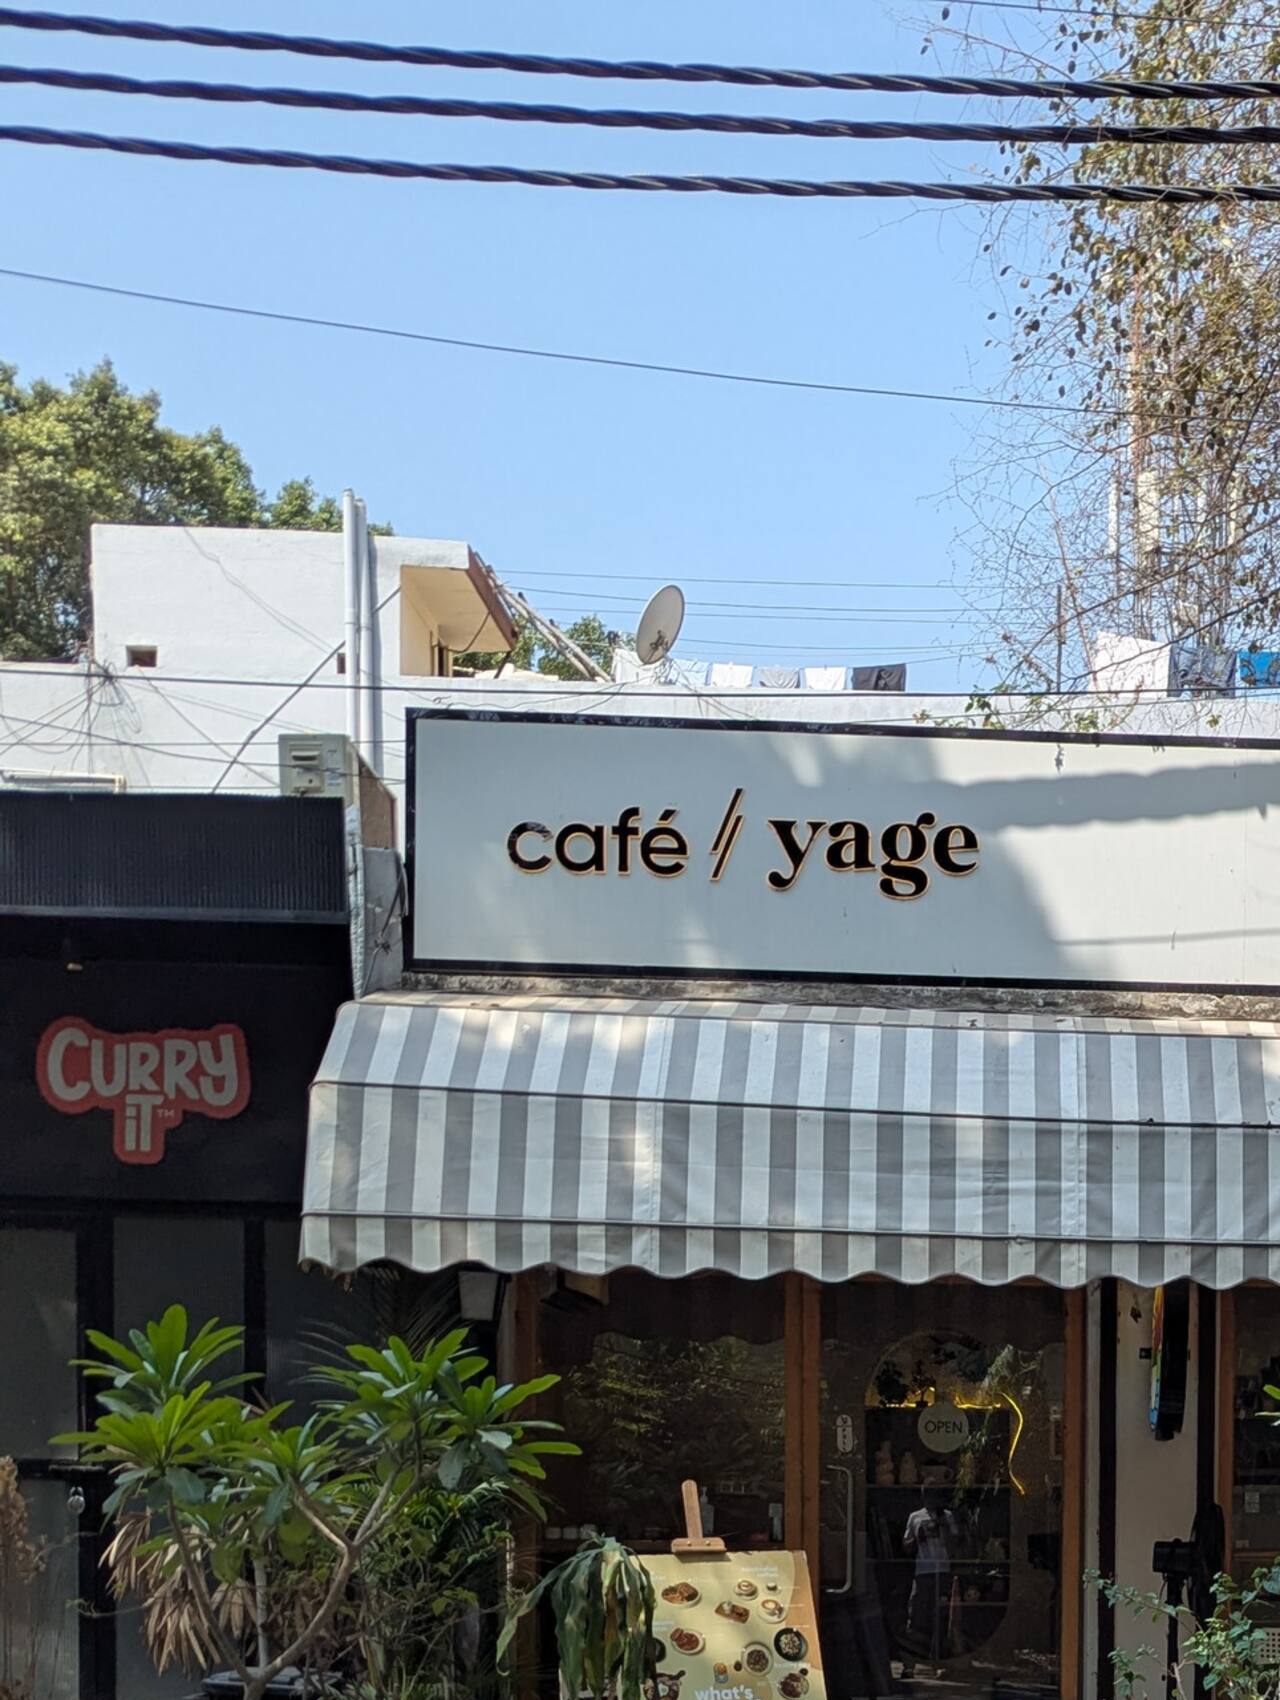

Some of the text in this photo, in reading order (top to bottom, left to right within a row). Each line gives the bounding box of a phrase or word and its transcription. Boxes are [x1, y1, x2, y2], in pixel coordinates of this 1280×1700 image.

[506, 806, 689, 877] café
[767, 811, 980, 901] yage
[47, 1026, 239, 1106] CURRY
[924, 1420, 963, 1434] OPEN
[694, 1684, 754, 1700] what's
